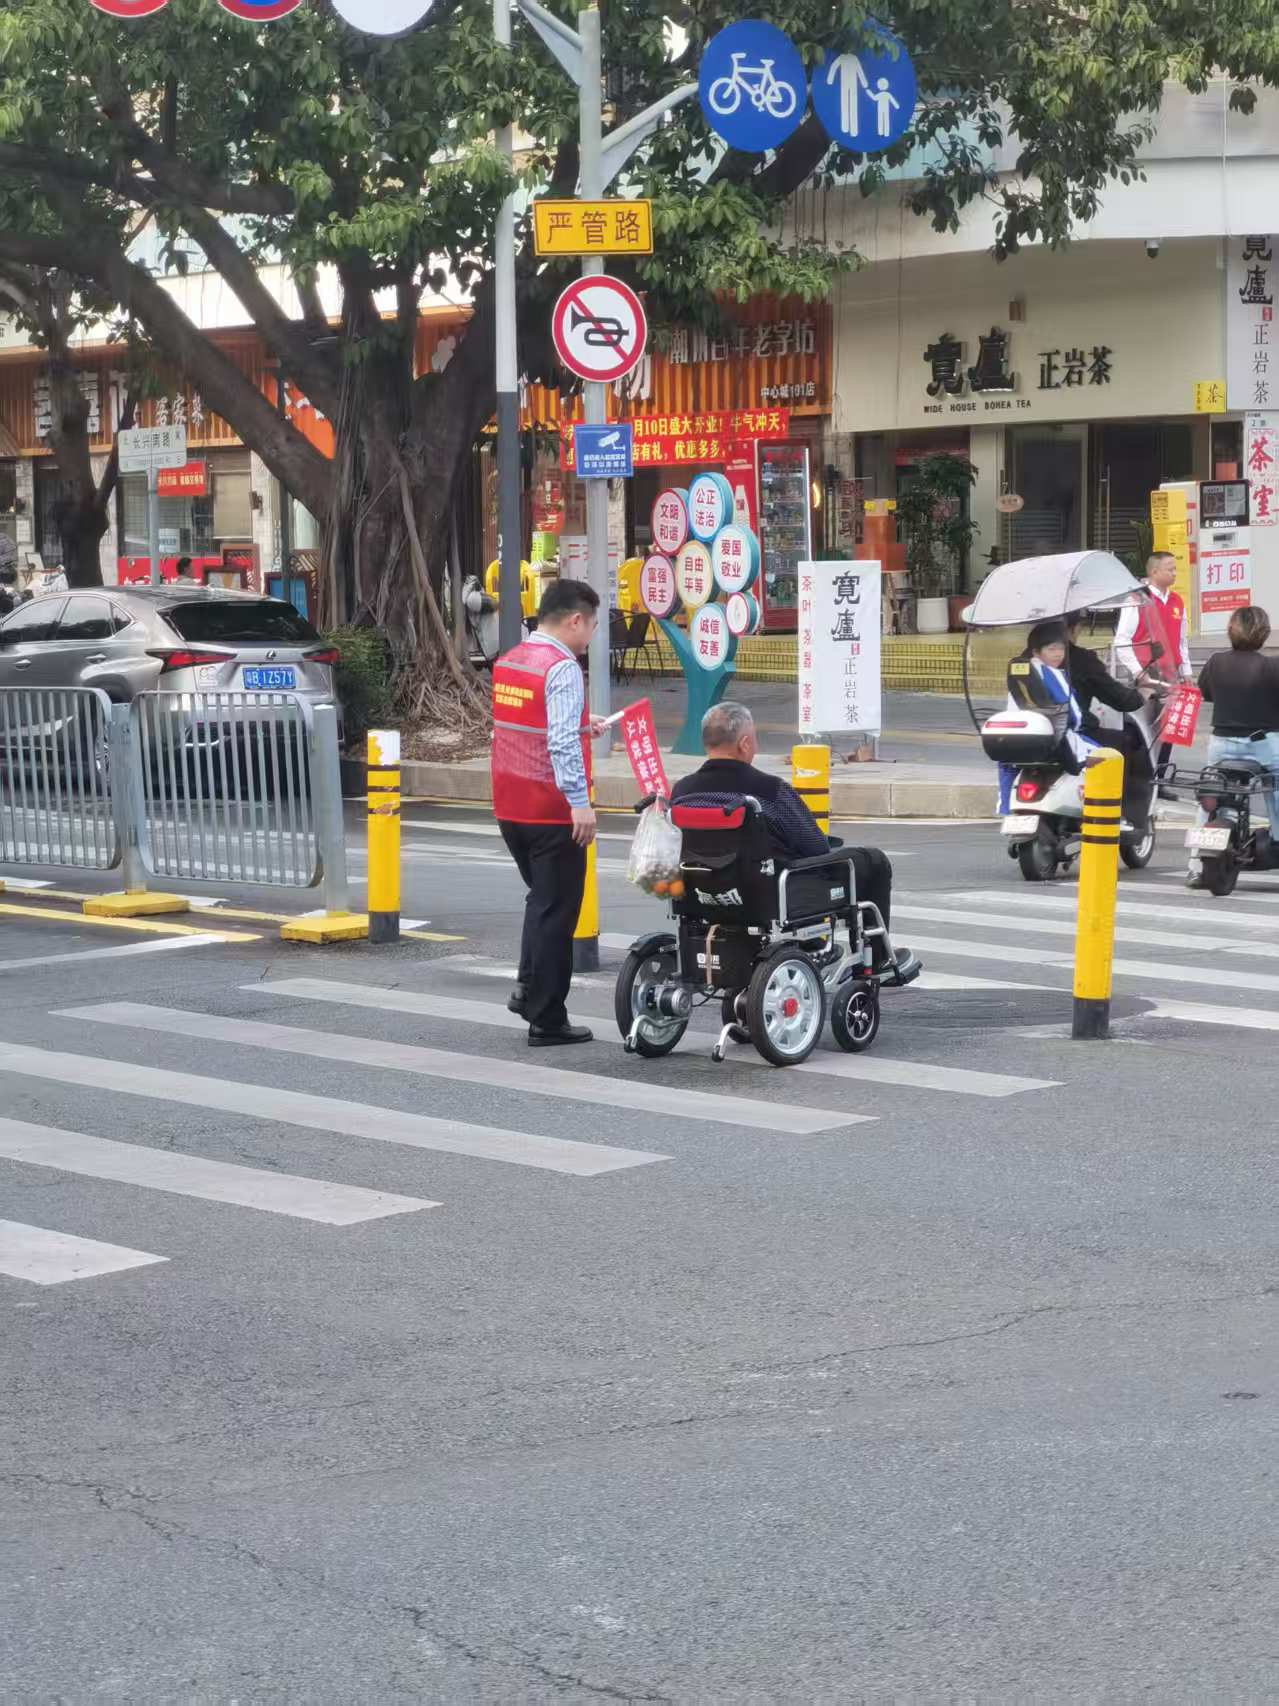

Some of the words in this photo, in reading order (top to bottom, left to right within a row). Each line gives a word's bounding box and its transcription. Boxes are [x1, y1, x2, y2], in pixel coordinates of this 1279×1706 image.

[547, 210, 640, 245] 严管路
[1037, 345, 1112, 390] 正岩茶
[1253, 323, 1269, 404] 正岩茶
[923, 405, 943, 414] WIDE
[950, 403, 976, 411] HOUSE
[984, 402, 1011, 410] BOHEA
[1016, 400, 1032, 408] TEA
[696, 487, 716, 506] 公正
[660, 503, 679, 520] 文明
[695, 510, 716, 528] 法治
[659, 523, 679, 542] 和谐
[720, 539, 742, 557] 爱国
[684, 556, 704, 572] 自由
[720, 561, 742, 578] 敬业
[648, 567, 667, 584] 富强
[1206, 562, 1245, 585] 打印
[684, 577, 704, 595] 平等
[648, 588, 667, 604] 民主
[699, 617, 721, 635] 诚信
[699, 640, 720, 657] 友善
[844, 656, 859, 724] 正岩茶
